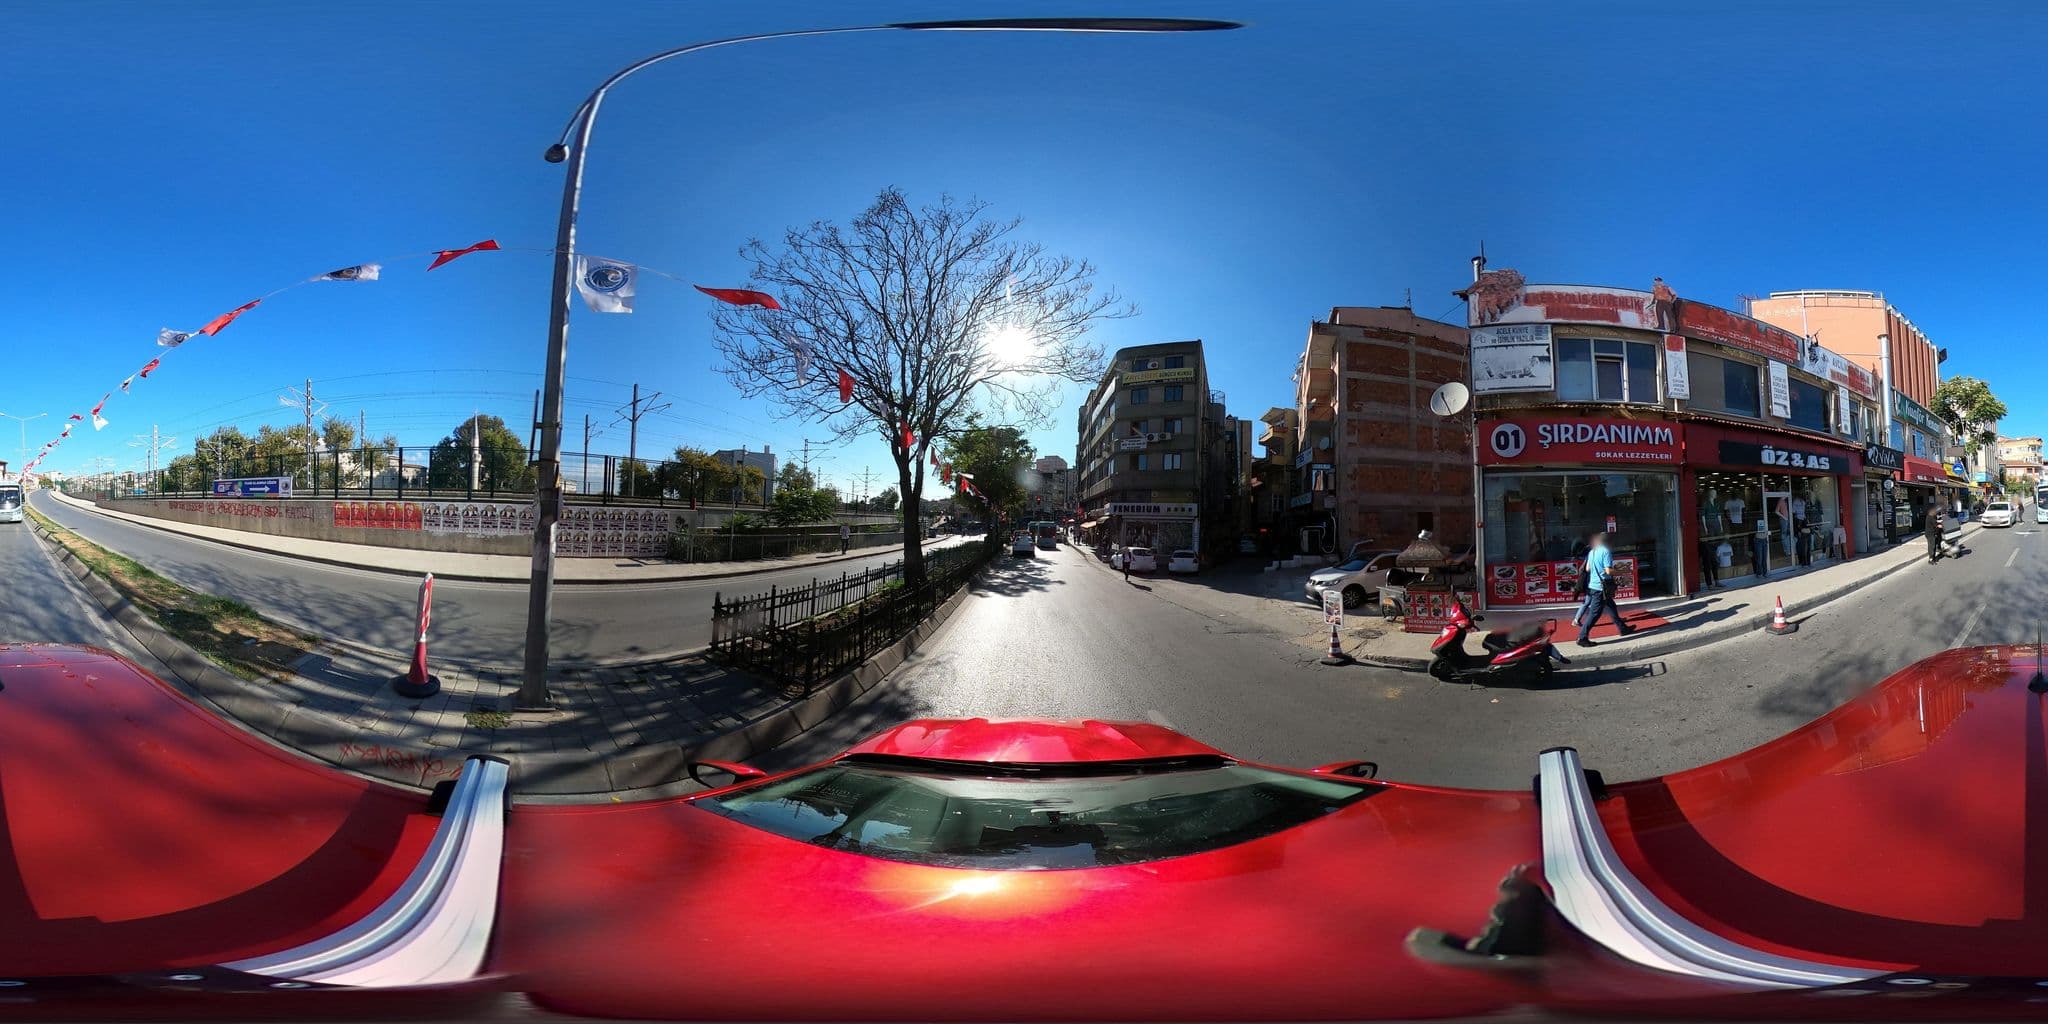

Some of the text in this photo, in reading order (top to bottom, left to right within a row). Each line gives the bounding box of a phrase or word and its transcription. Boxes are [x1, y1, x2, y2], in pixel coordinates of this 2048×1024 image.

[1495, 423, 1674, 451] 01 ŞIRDANIMM
[1625, 452, 1672, 460] LEZZETLERİ
